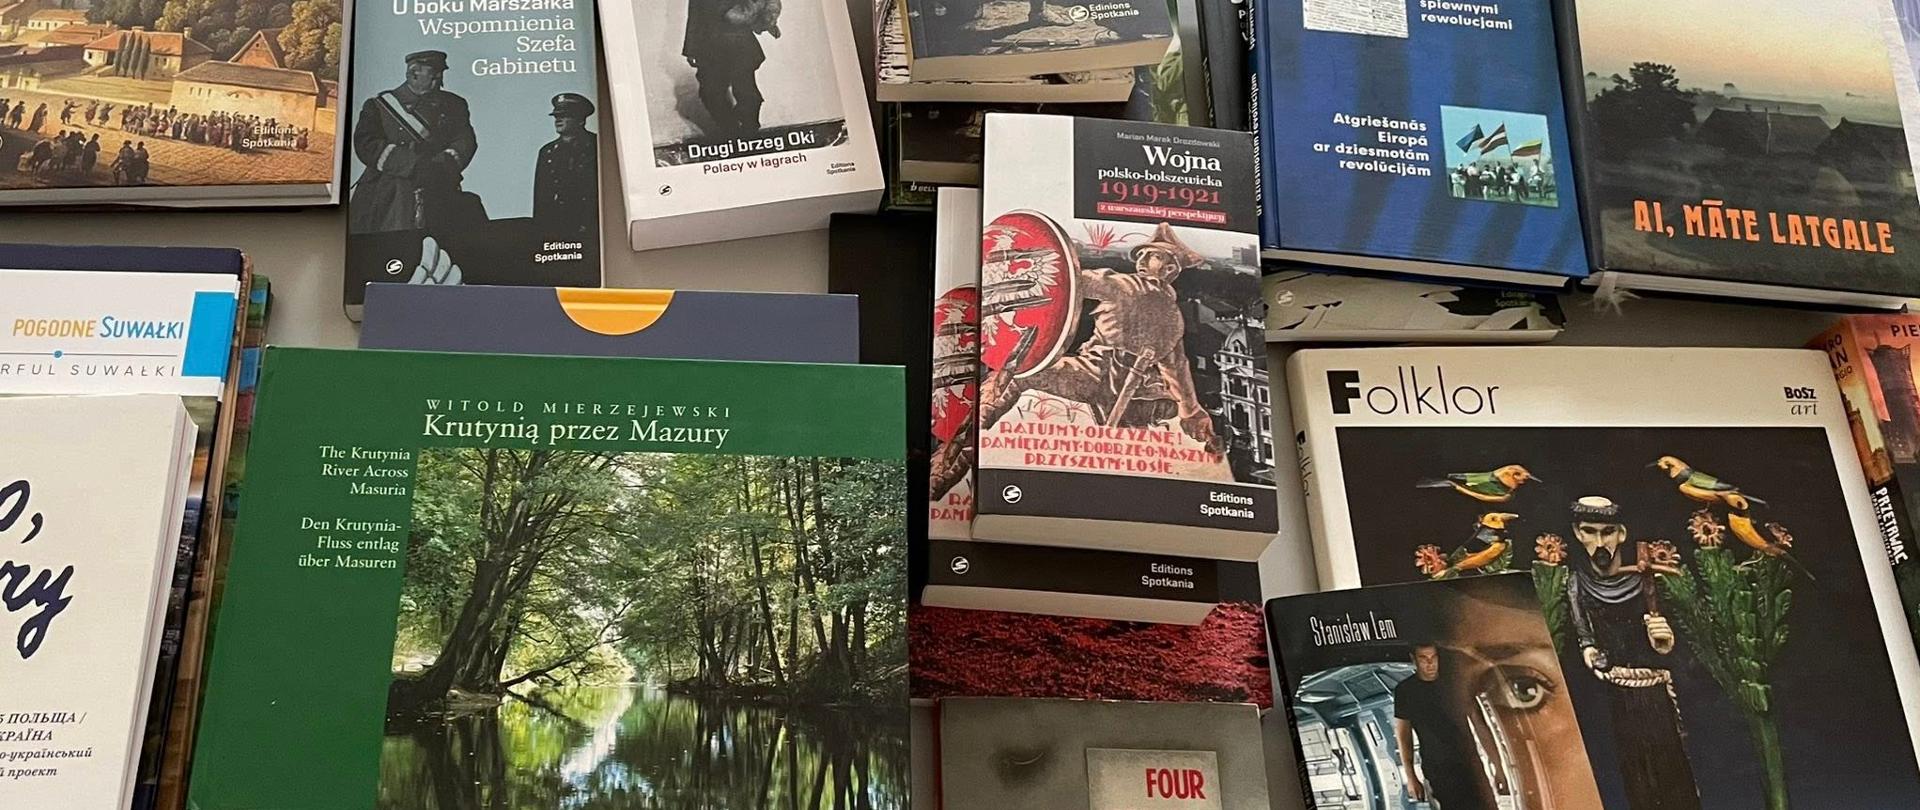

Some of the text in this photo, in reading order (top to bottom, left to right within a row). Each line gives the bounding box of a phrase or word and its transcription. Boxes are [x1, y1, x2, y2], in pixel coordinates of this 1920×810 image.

[393, 0, 574, 15] U boku Marszałka
[1090, 8, 1140, 20] Spotkania
[418, 15, 575, 38] Wspomnienia
[1421, 13, 1513, 30] rewolucjami
[516, 34, 576, 53] Szefa
[471, 57, 577, 76] Gabinetu
[1333, 112, 1427, 131] Atgriešanās
[242, 138, 297, 149] Spotkania
[688, 130, 815, 159] Drugi brzeg Oki
[1116, 132, 1145, 141] Marian
[1146, 135, 1171, 144] Marek
[1378, 131, 1428, 147] Eiropā
[1142, 145, 1221, 173] Wojna
[1313, 143, 1430, 161] ar dziesmotām
[703, 161, 744, 175] Polacy
[746, 160, 758, 169] w
[1339, 160, 1431, 177] revolūcijām
[1098, 167, 1223, 187] polsko-bolszewicka
[1100, 181, 1221, 207] 1919-1921
[1107, 205, 1167, 218] warszawskiej
[1168, 210, 1225, 222] perspektywy
[1633, 199, 1896, 254] AI, MĀTE LATGALE
[543, 242, 583, 251] Editions
[534, 252, 583, 263] Spotkania
[12, 316, 184, 340] POGODNE SUWAŁKI
[1890, 324, 1920, 338] PIE
[70, 364, 176, 377] SUWAŁKI
[1326, 364, 1500, 416] Folklor
[426, 399, 731, 418] WITOLD MIERZEJEWSKI
[1790, 403, 1817, 416] art
[422, 414, 730, 449] Krutynią przez Mazury
[319, 445, 411, 463] The Krutynia
[322, 463, 409, 478] River Across
[350, 482, 406, 496] Masuria
[1210, 491, 1254, 506] Editions
[1200, 503, 1255, 519] Spotkania
[301, 517, 402, 535] Den Krutynia-
[317, 536, 399, 554] Fluss entlag
[298, 554, 397, 569] über Masuren
[1151, 563, 1194, 576] Editions
[1141, 575, 1195, 590] Spotkania
[1369, 610, 1397, 641] Lem
[7, 712, 76, 725] ПОЛЬЩА
[79, 712, 87, 725] /
[1145, 768, 1206, 800] FOUR
